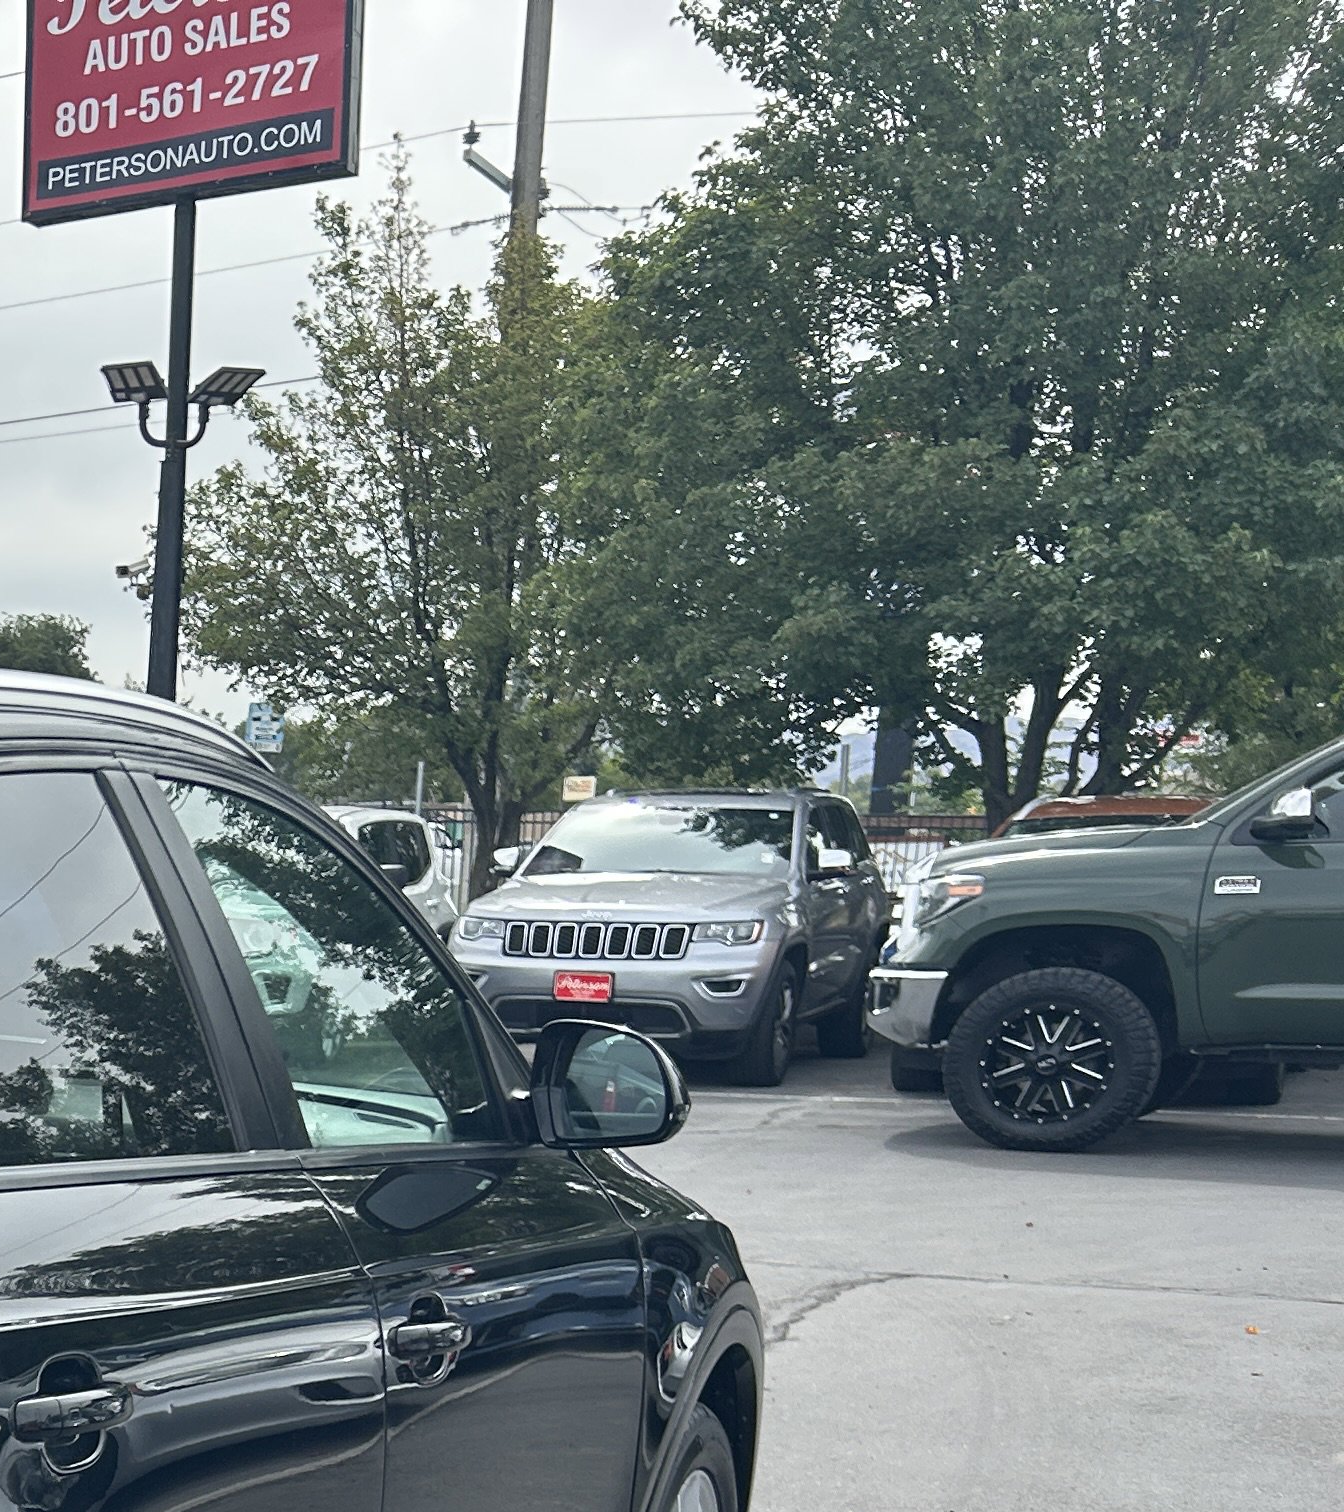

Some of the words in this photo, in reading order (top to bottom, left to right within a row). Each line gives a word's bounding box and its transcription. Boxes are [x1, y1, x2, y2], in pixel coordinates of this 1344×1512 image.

[83, 25, 172, 75] AUTO
[184, 6, 291, 57] SALES
[55, 54, 319, 138] 801-561-2727
[48, 119, 322, 191] PETERSONAUTO.COM
